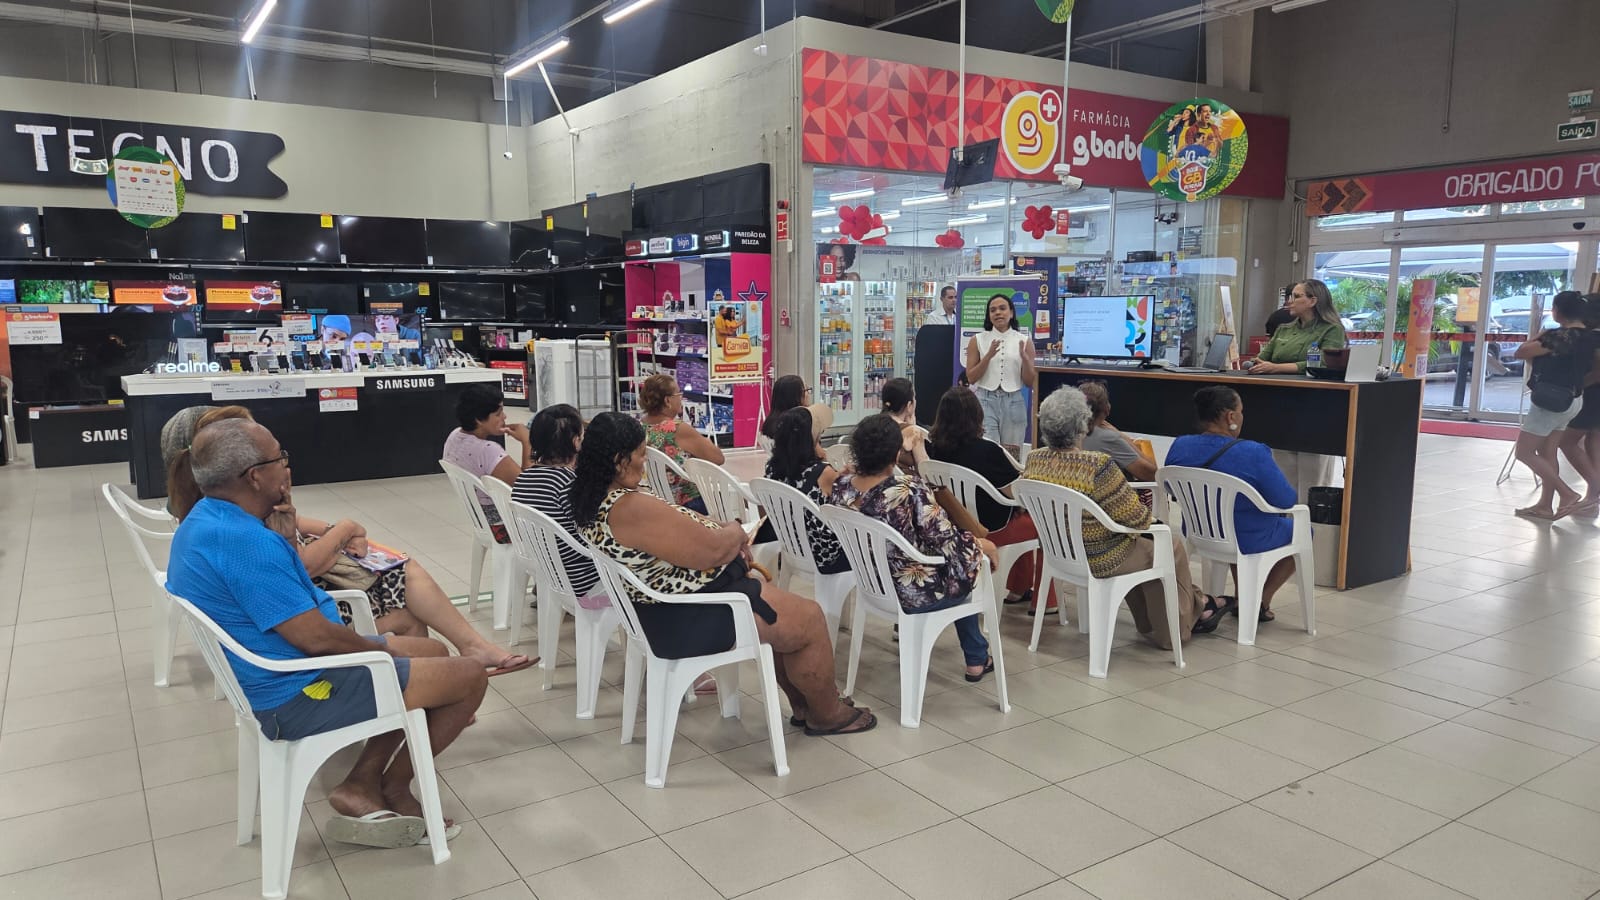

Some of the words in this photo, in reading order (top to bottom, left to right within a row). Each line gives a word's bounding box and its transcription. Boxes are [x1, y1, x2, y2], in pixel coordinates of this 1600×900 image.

[1073, 109, 1130, 128] FARMÁCIA
[1561, 126, 1593, 137] SAÍDA
[1445, 166, 1564, 198] OBRIGADO
[157, 360, 220, 373] realme
[376, 378, 435, 390] SAMSUNG
[82, 428, 128, 443] SAMS
